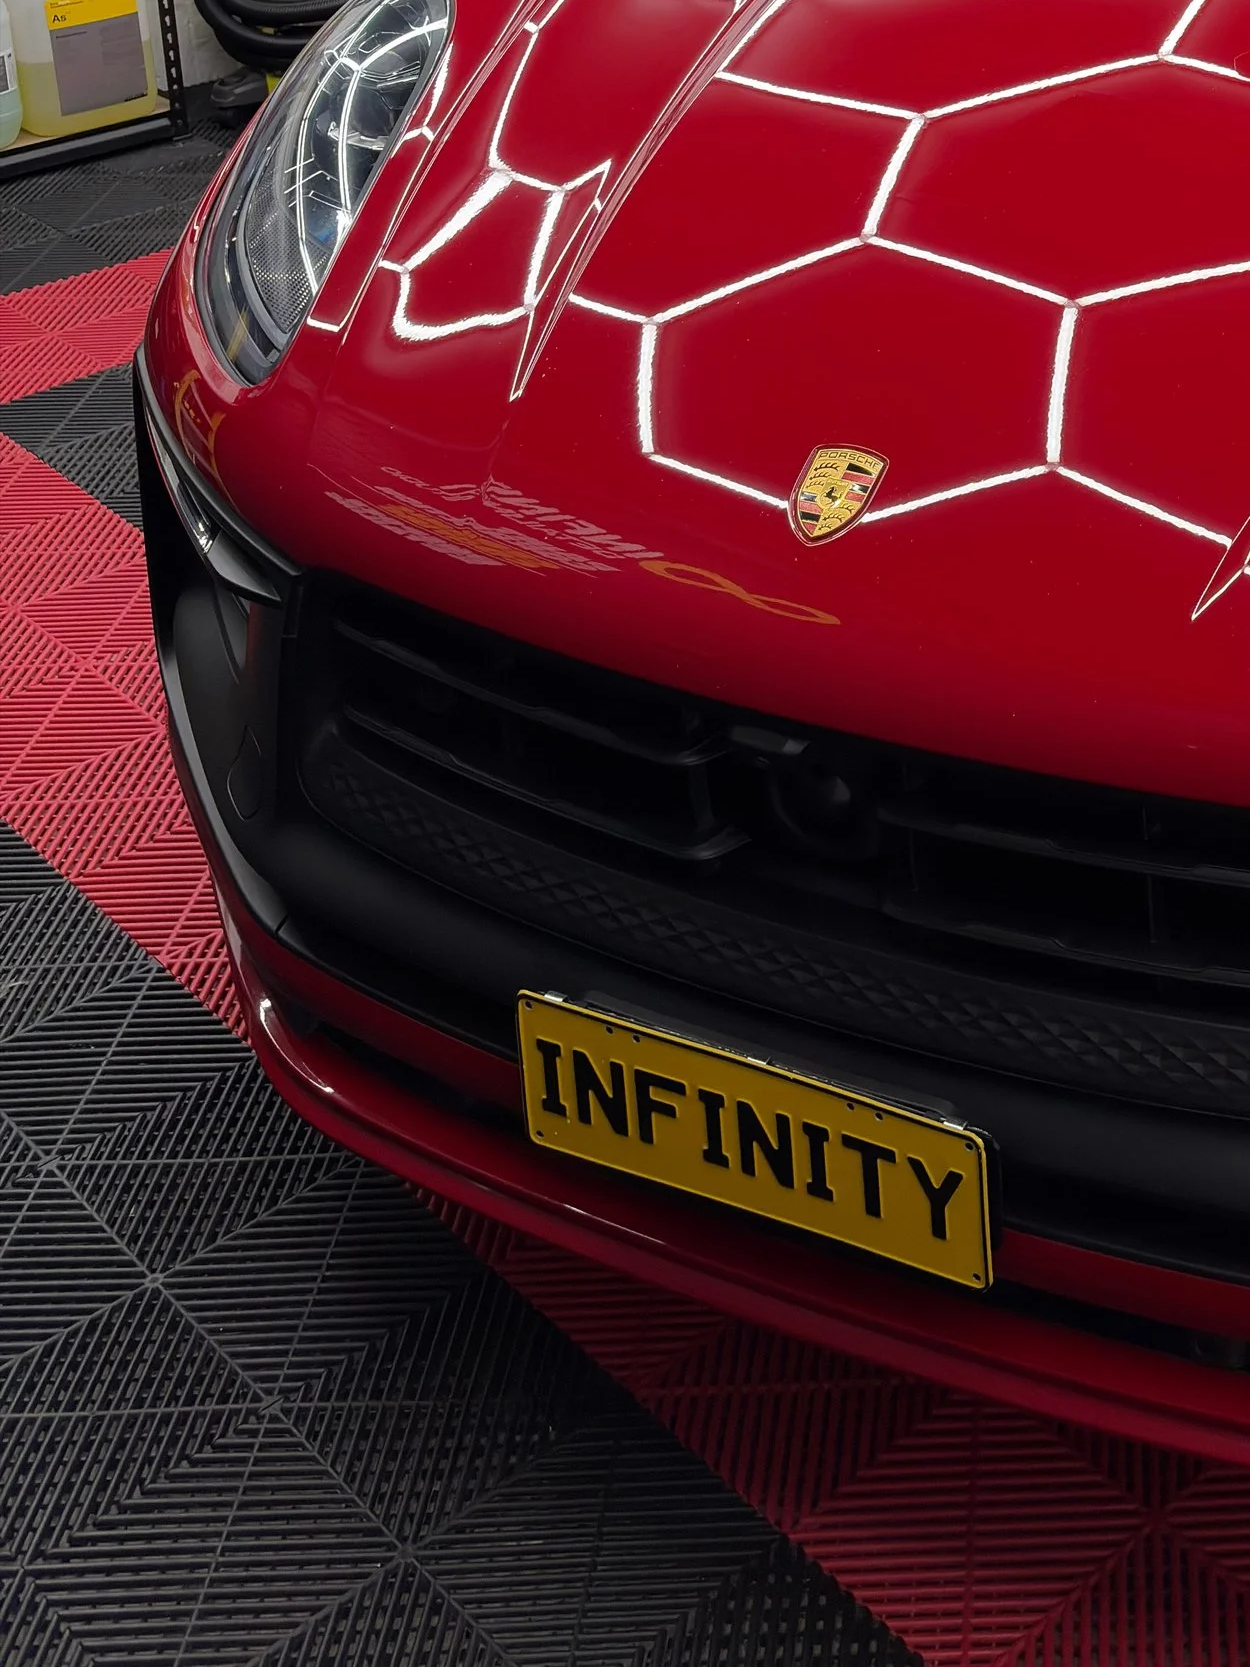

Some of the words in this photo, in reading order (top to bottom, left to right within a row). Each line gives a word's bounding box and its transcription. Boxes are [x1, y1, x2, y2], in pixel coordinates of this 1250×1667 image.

[51, 14, 67, 24] As
[818, 450, 880, 468] PORSCHE
[535, 1037, 964, 1241] INFINITY
